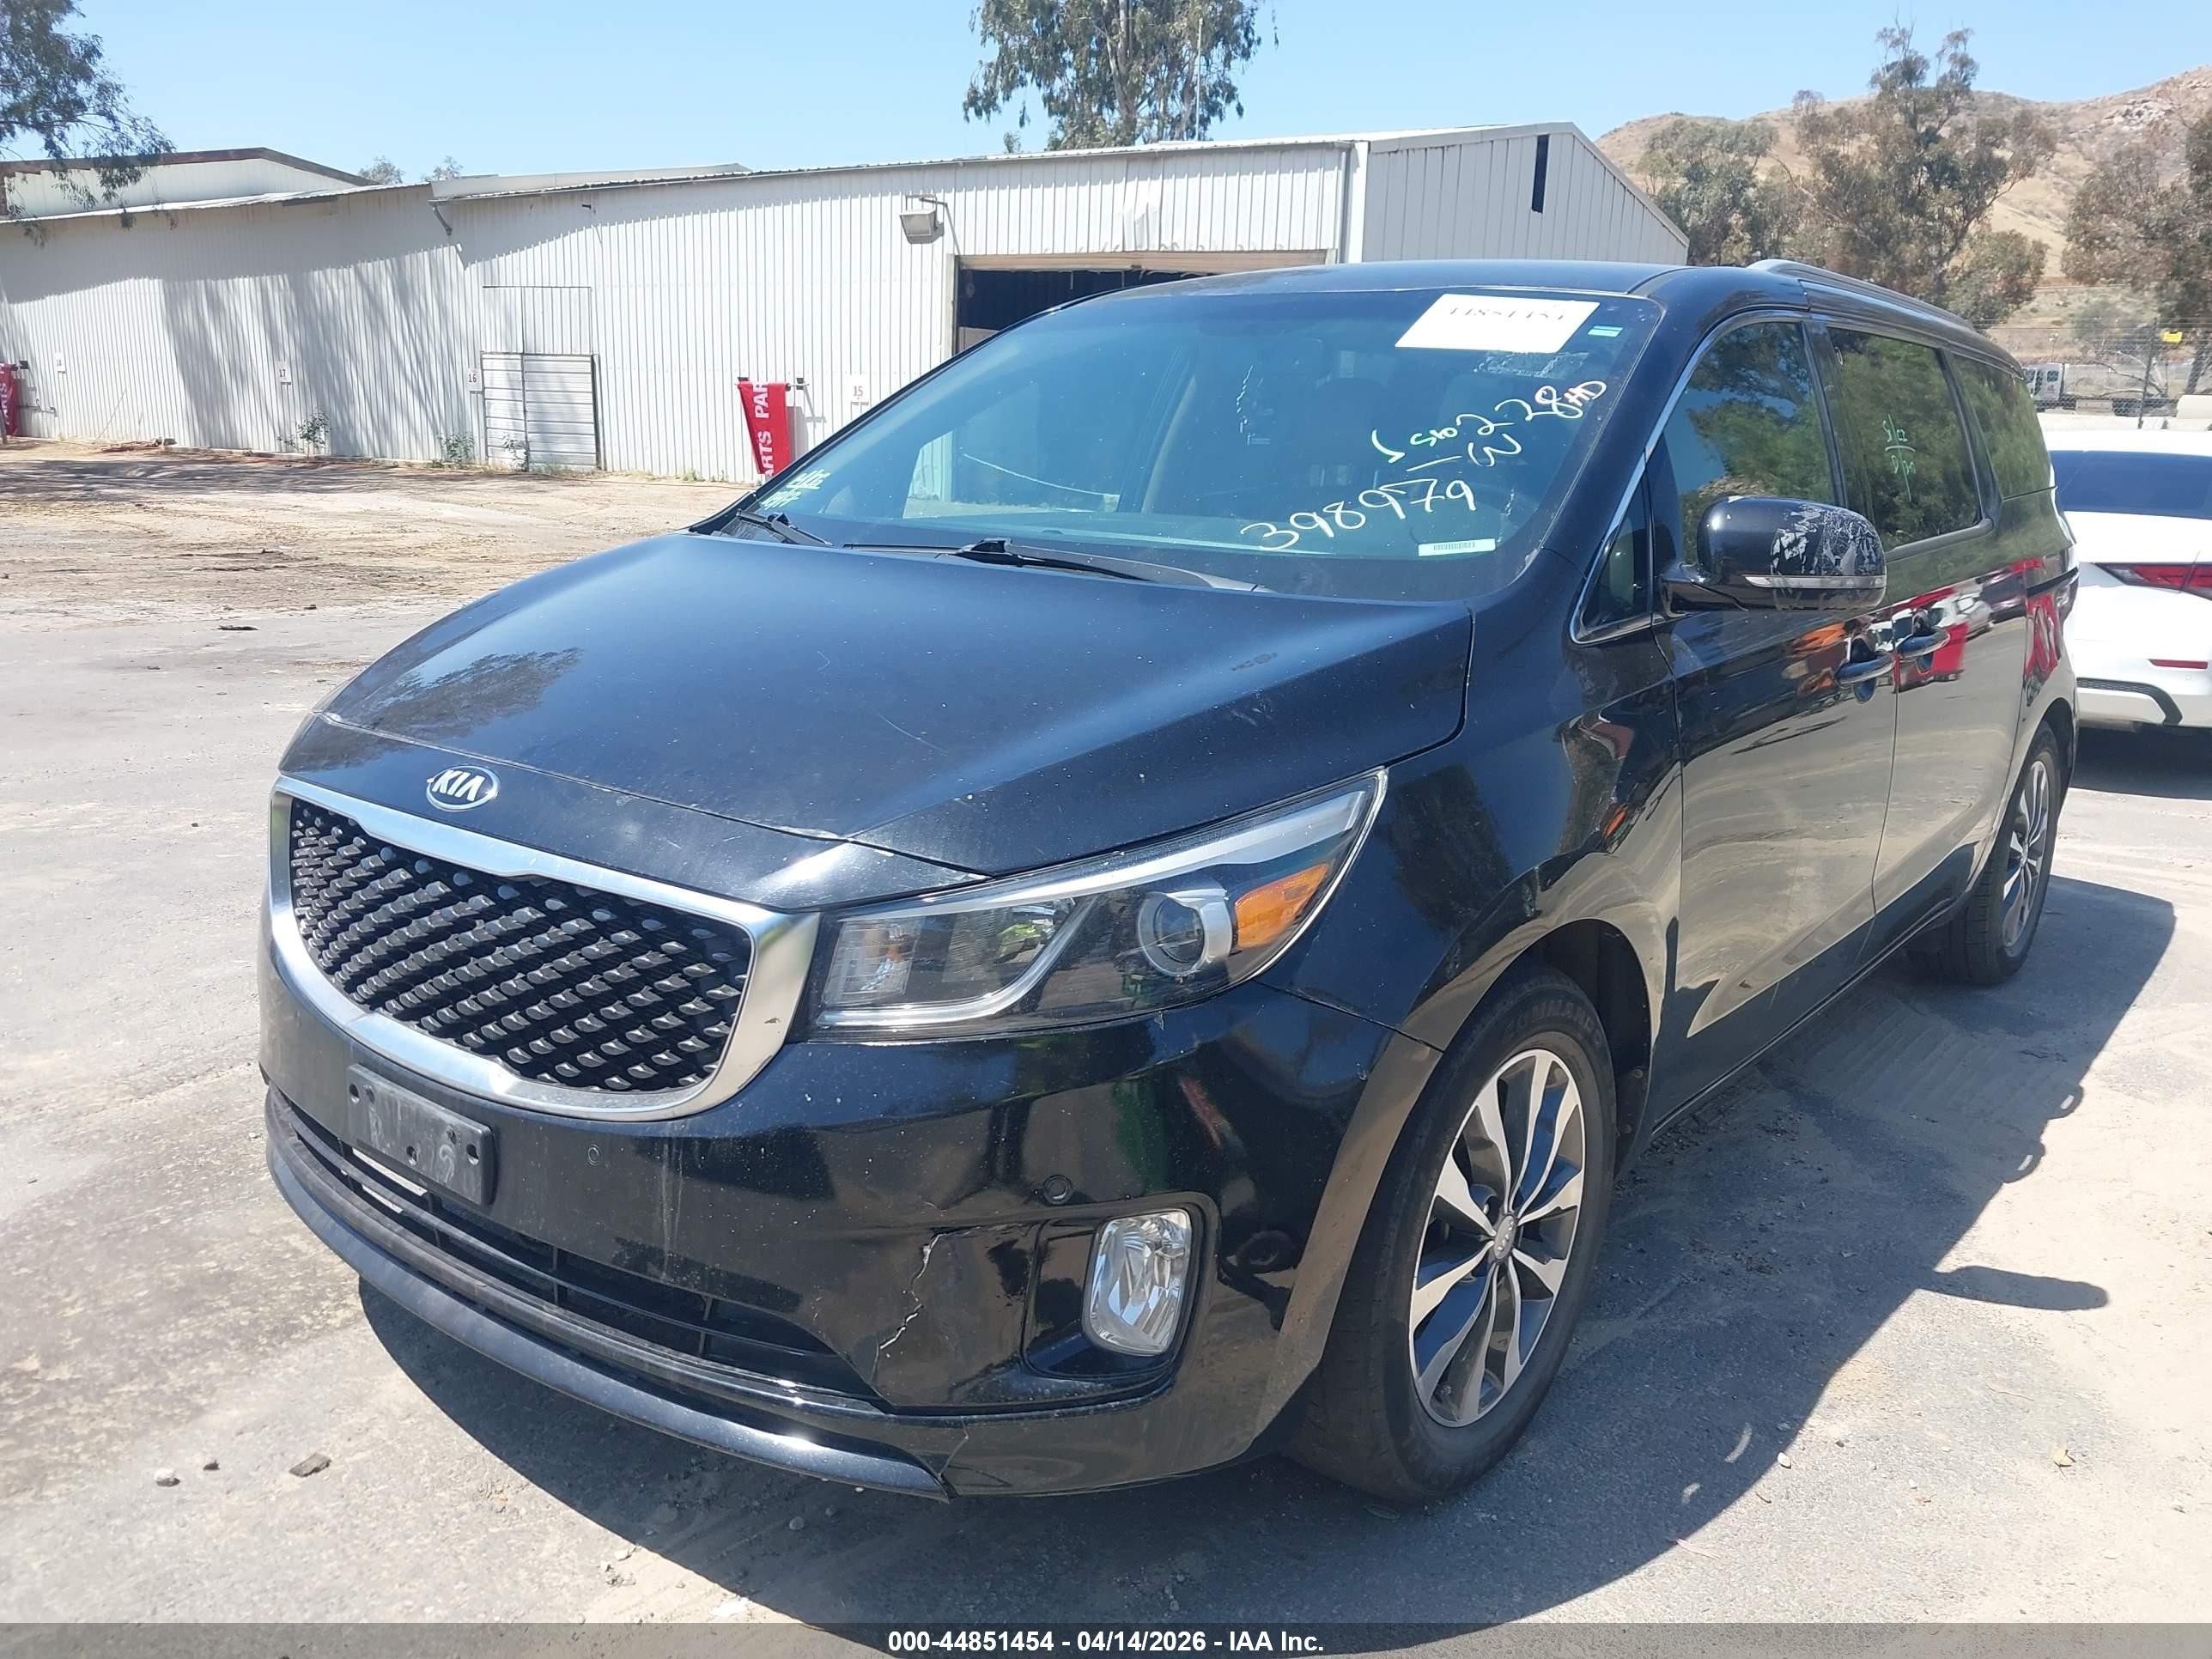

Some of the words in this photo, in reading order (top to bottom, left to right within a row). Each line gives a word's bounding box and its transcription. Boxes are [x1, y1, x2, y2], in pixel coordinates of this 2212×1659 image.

[468, 374, 477, 383] 16
[854, 386, 864, 397] 15
[1239, 477, 1477, 551] 398979
[431, 769, 486, 802] KIA
